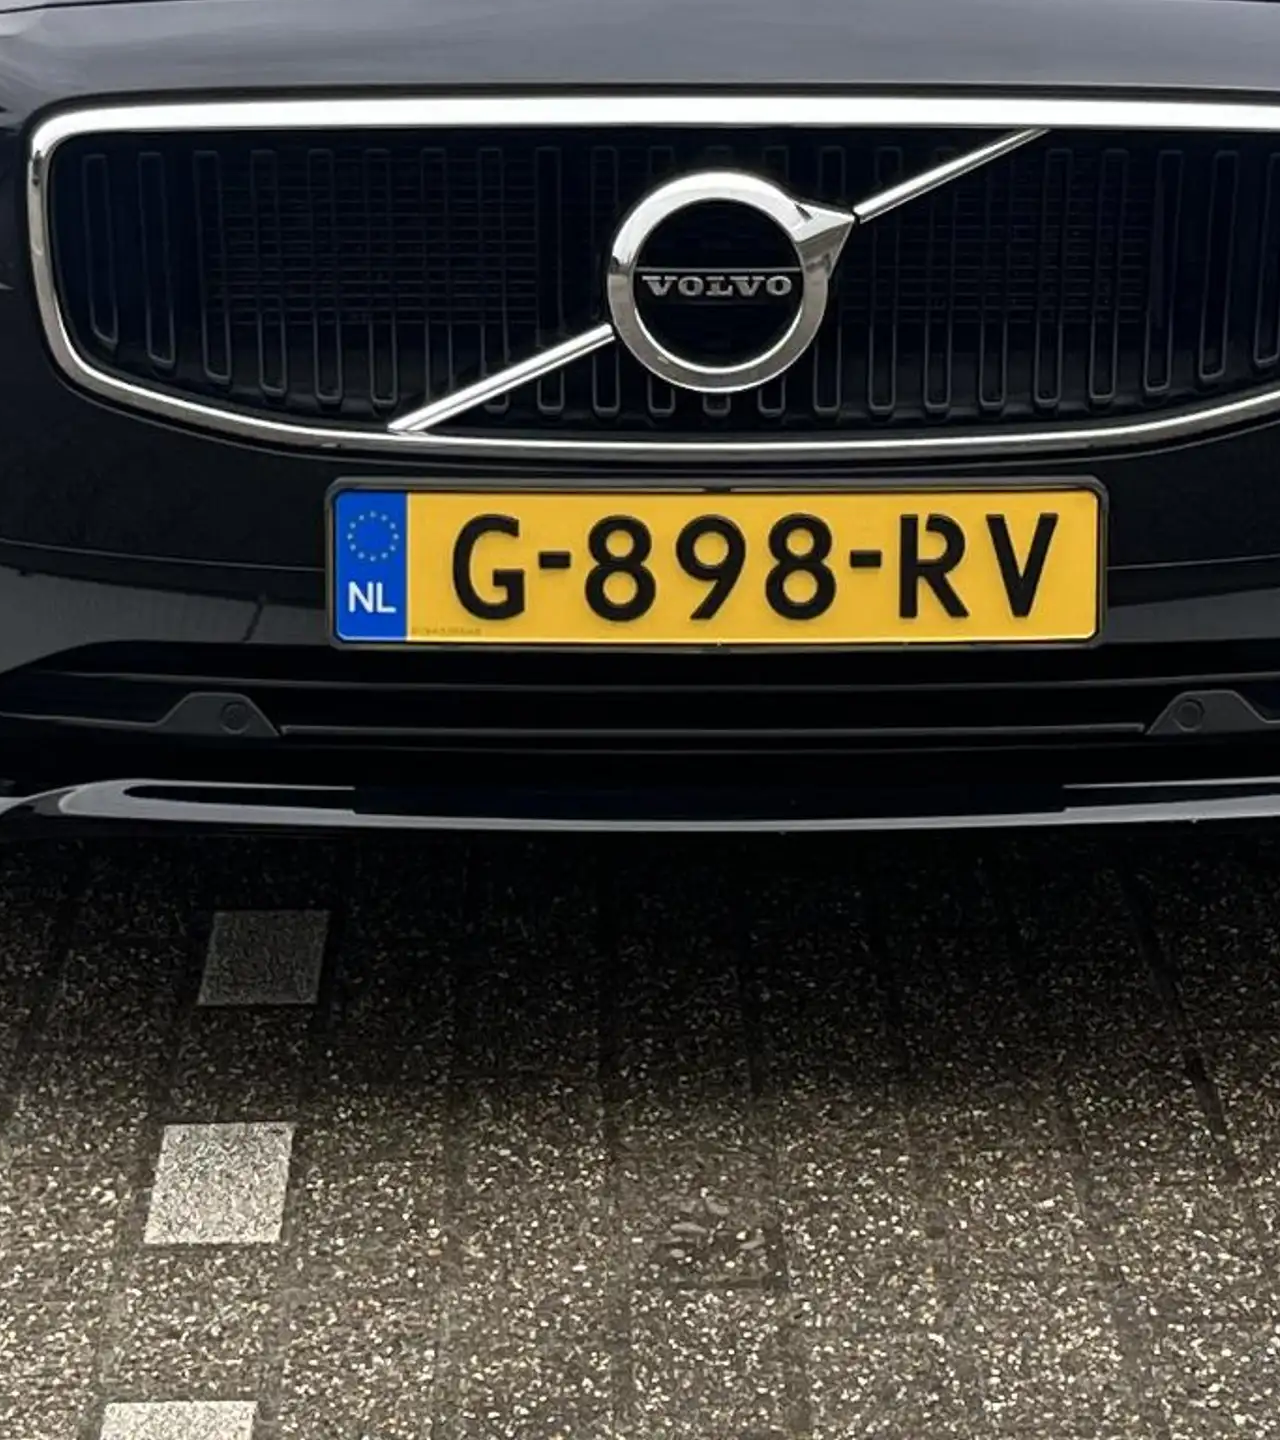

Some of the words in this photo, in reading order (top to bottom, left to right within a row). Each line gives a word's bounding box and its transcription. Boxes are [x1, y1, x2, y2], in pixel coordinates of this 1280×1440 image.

[641, 275, 792, 296] VOLVO
[451, 513, 1059, 621] G-898-RV
[348, 582, 396, 614] NL
